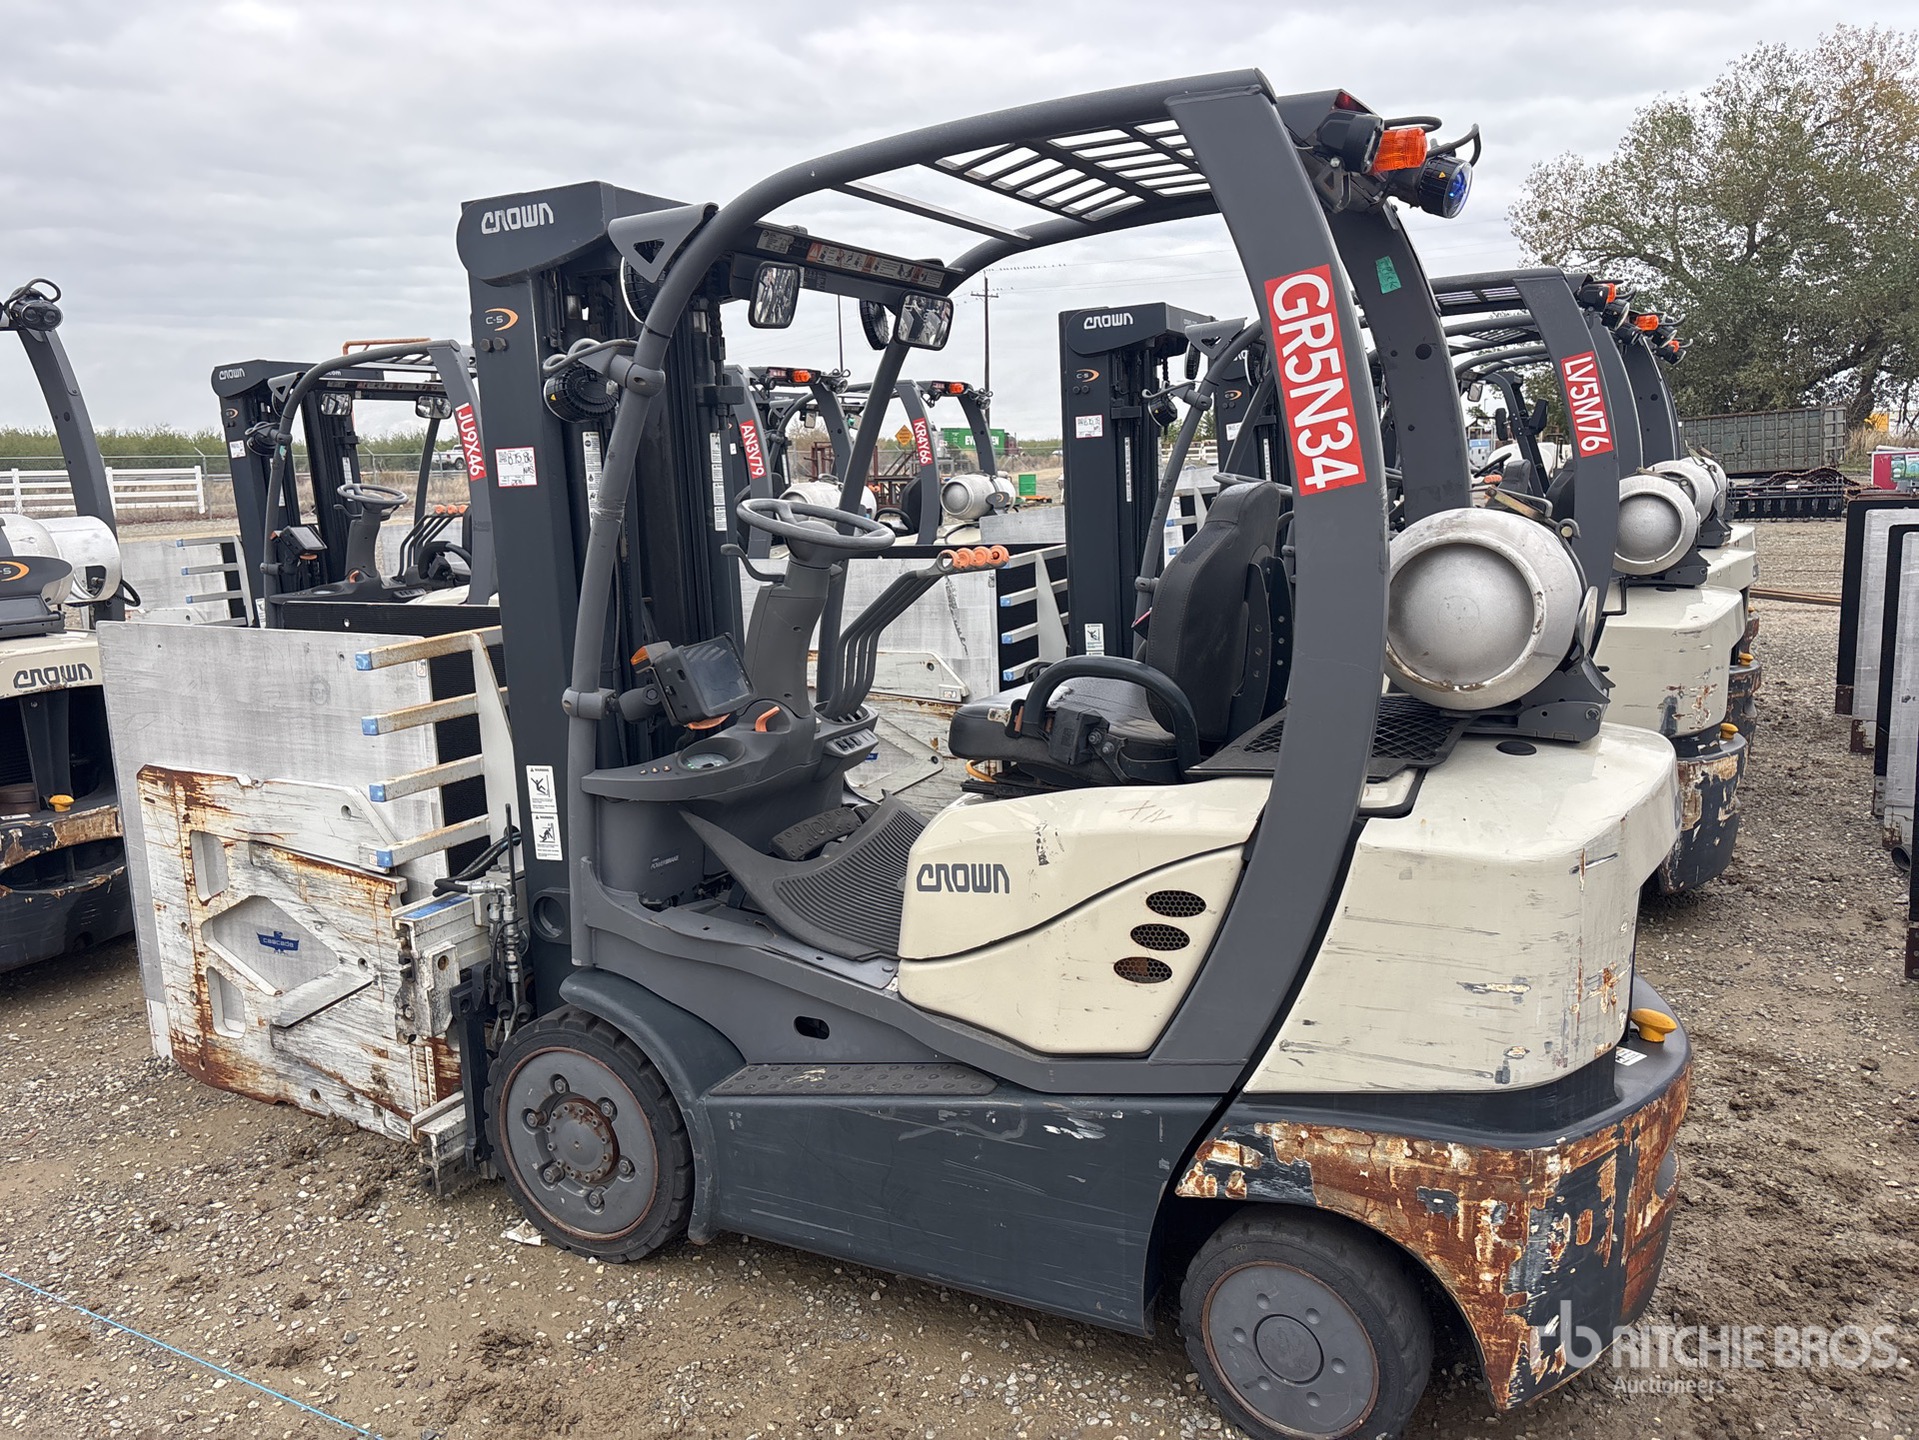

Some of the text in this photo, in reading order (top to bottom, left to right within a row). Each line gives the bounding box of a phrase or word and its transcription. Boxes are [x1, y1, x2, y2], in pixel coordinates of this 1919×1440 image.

[480, 203, 555, 235] CROWN
[1083, 312, 1134, 330] CROWN
[218, 367, 246, 381] CROWN
[1273, 273, 1360, 490] GR5N34
[1564, 356, 1610, 452] LV5M76
[458, 412, 485, 477] JU9X46
[741, 425, 765, 476] AN3V79
[914, 420, 932, 464] KR4Y66
[13, 662, 94, 689] CROWN
[916, 863, 1011, 894] CROWN
